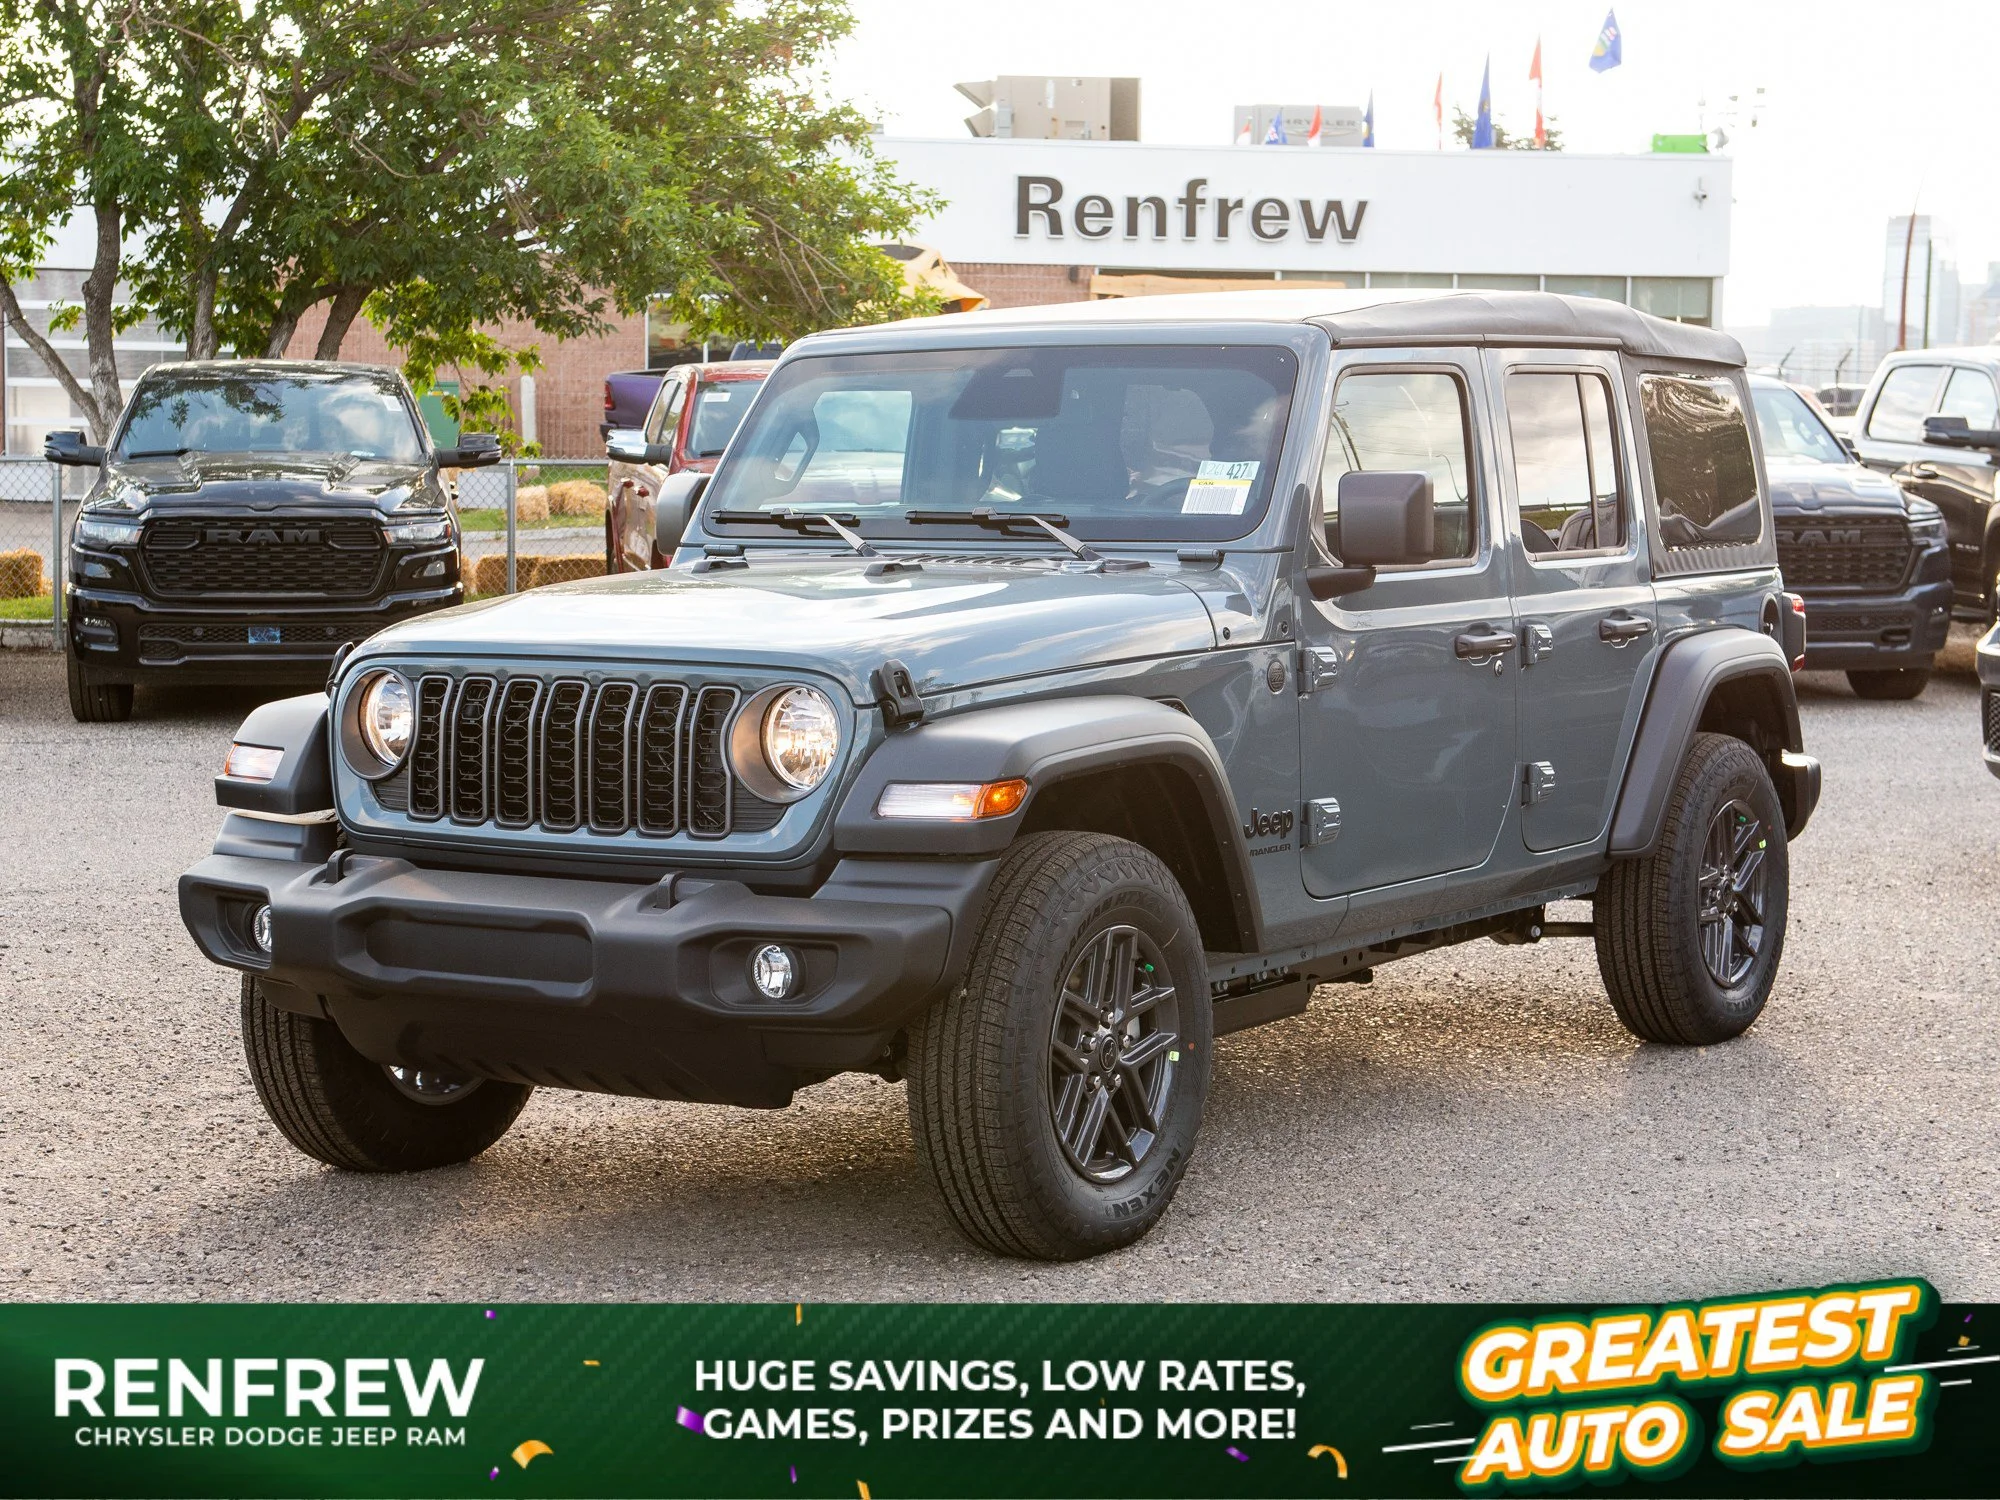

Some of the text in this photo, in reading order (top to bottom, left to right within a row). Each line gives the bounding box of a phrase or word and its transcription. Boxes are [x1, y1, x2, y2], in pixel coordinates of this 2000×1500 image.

[1016, 174, 1369, 243] Renfrew
[1226, 462, 1249, 479] 427
[206, 529, 321, 543] RAM
[1776, 530, 1861, 544] RAM
[1243, 808, 1294, 839] Jeep
[1111, 1147, 1181, 1219] NEXEN
